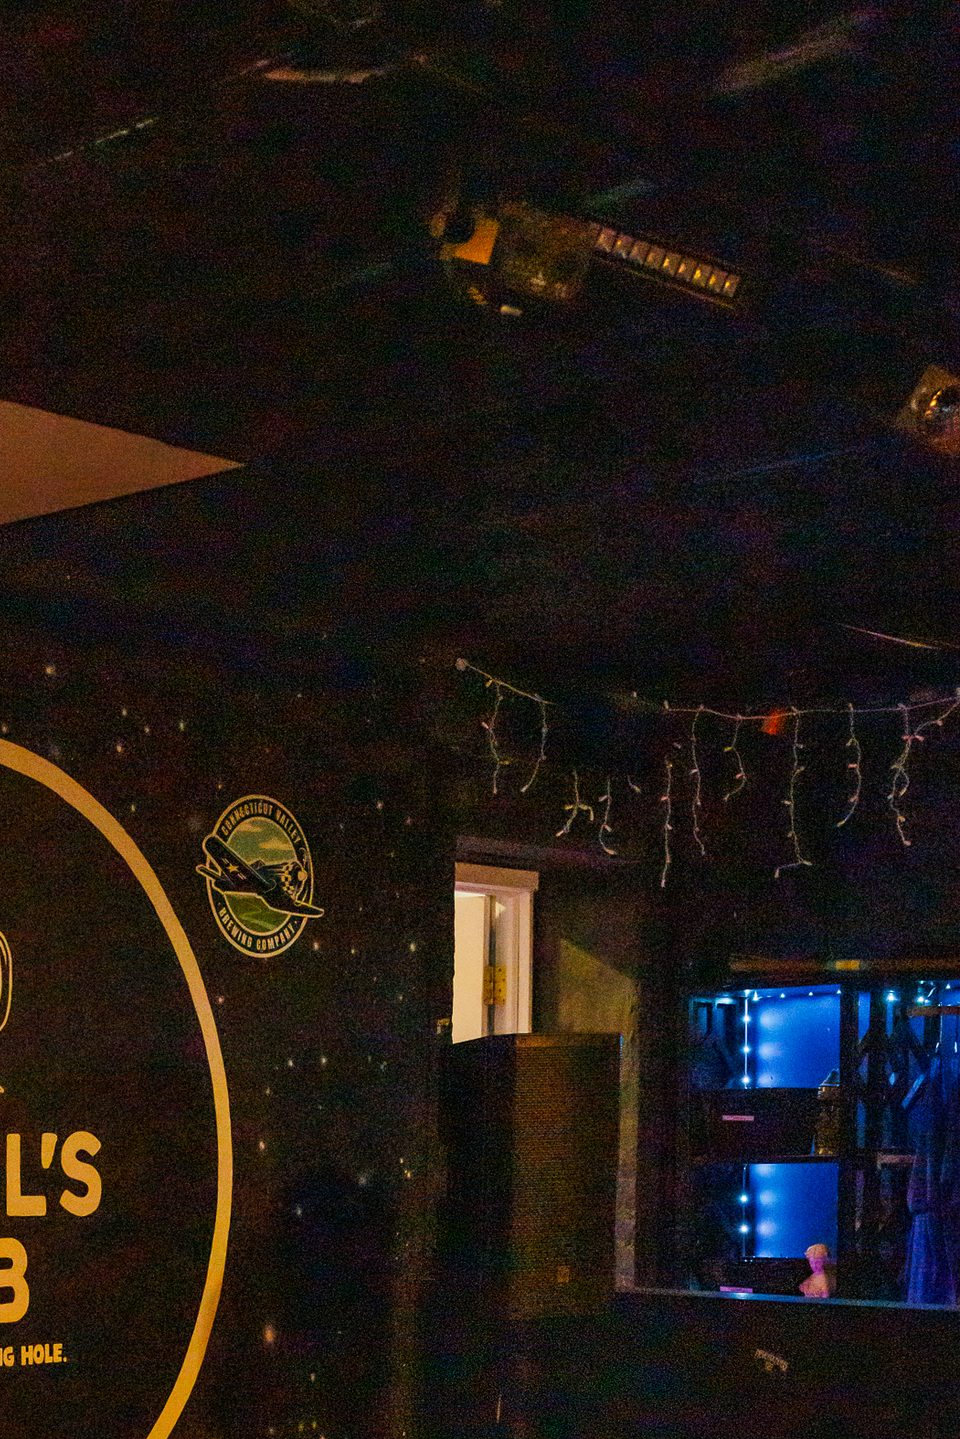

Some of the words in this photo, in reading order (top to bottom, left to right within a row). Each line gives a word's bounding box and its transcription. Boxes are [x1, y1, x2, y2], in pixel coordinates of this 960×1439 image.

[220, 802, 274, 836] CONNECTICUT
[276, 807, 302, 844] VALLEY
[218, 907, 253, 949] BREWING
[256, 924, 296, 951] COMPANY
[21, 1343, 68, 1366] HOLE.
